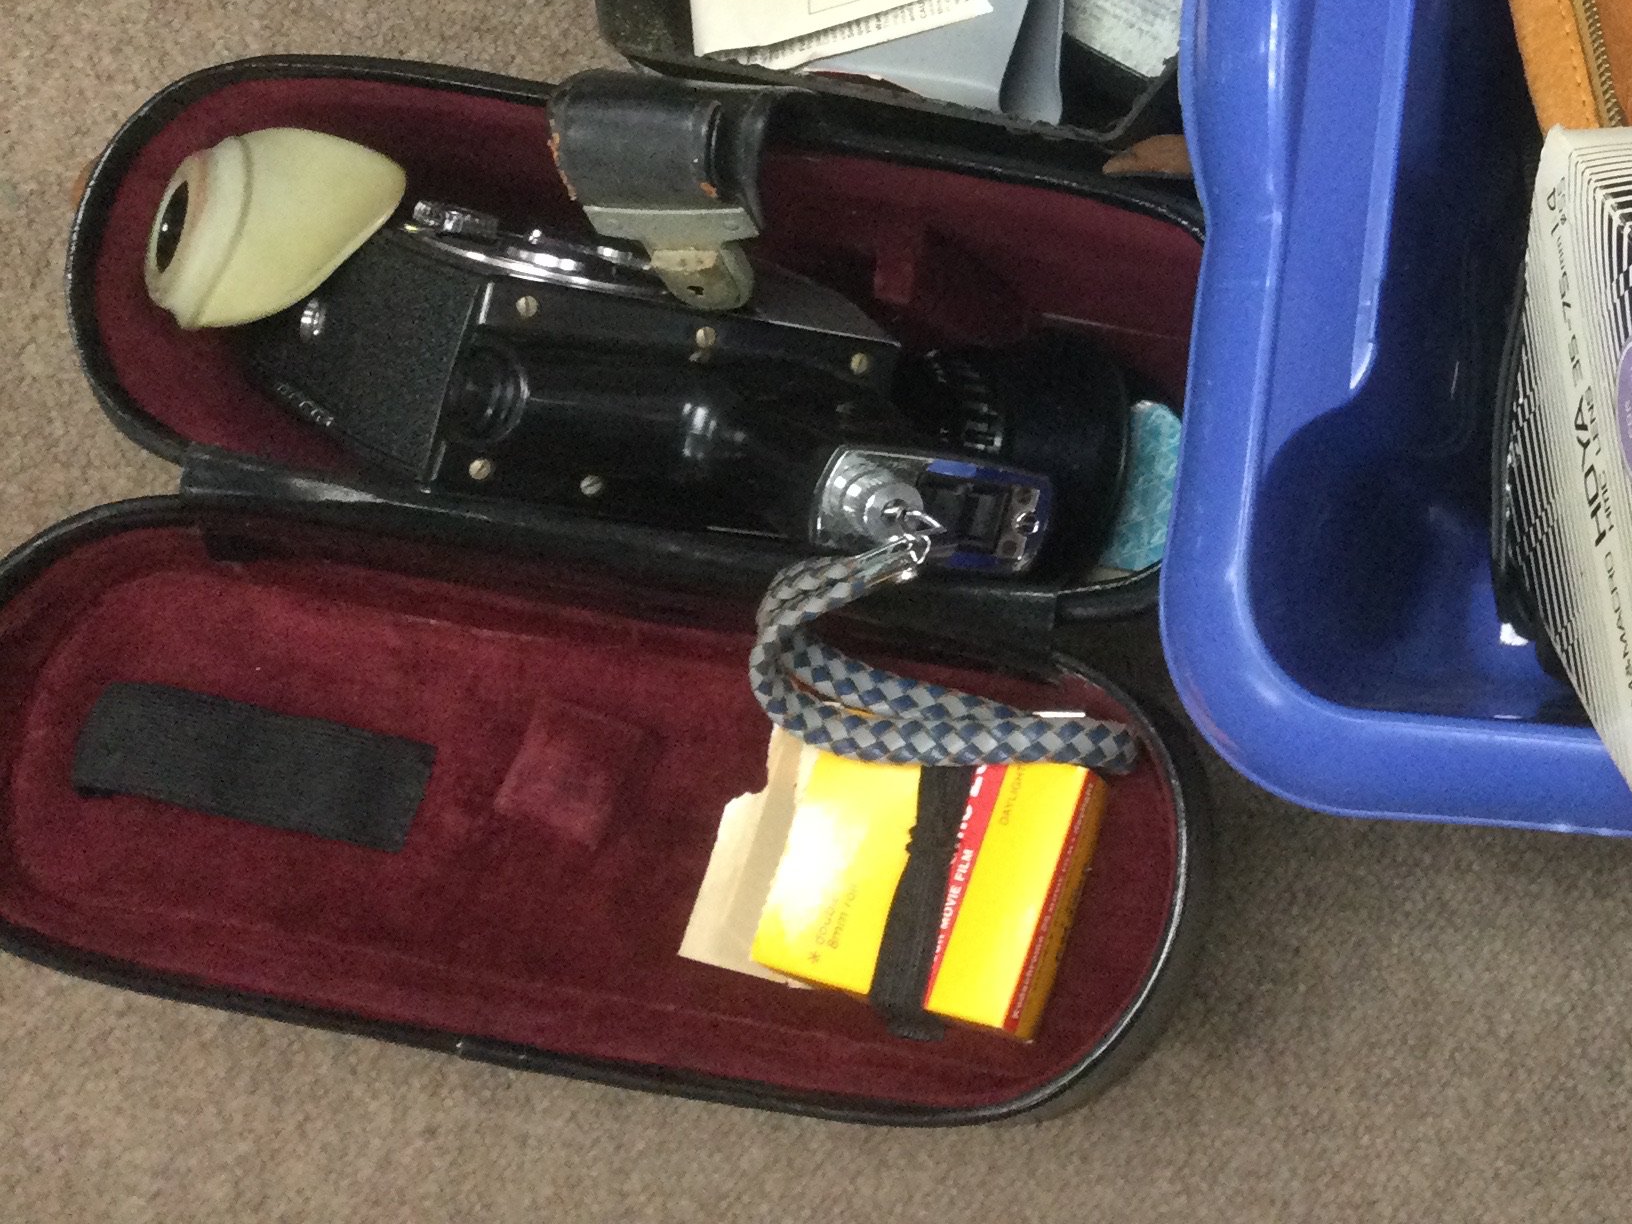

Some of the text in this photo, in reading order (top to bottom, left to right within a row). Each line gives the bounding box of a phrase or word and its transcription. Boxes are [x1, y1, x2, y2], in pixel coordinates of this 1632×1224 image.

[1574, 394, 1607, 548] HOYA
[938, 880, 964, 930] MOVIE
[953, 847, 976, 888] FILM
